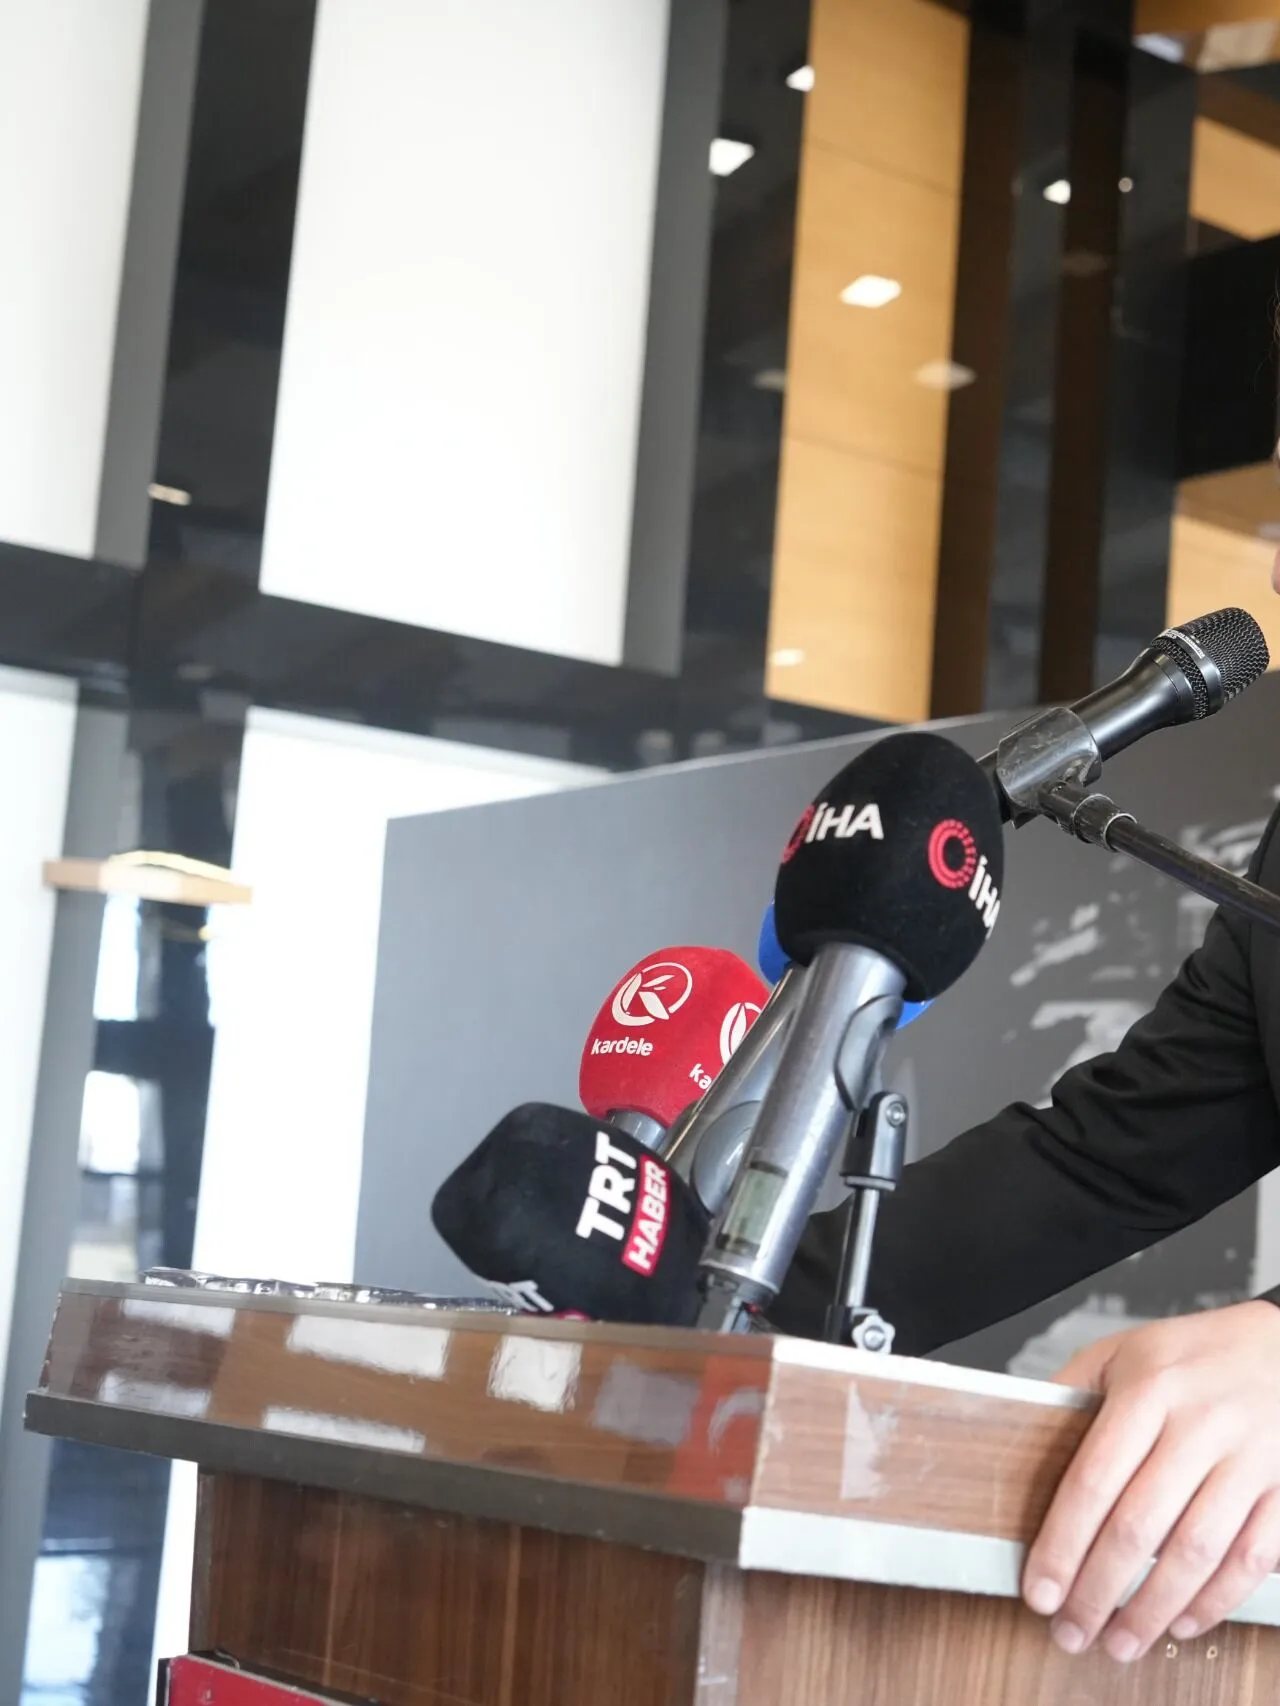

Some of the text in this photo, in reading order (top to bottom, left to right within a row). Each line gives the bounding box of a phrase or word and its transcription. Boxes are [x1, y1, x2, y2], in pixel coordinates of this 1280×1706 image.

[804, 802, 885, 843] İHA
[591, 1036, 653, 1056] kardele
[575, 1130, 637, 1241] TRT
[628, 1159, 667, 1270] HABER
